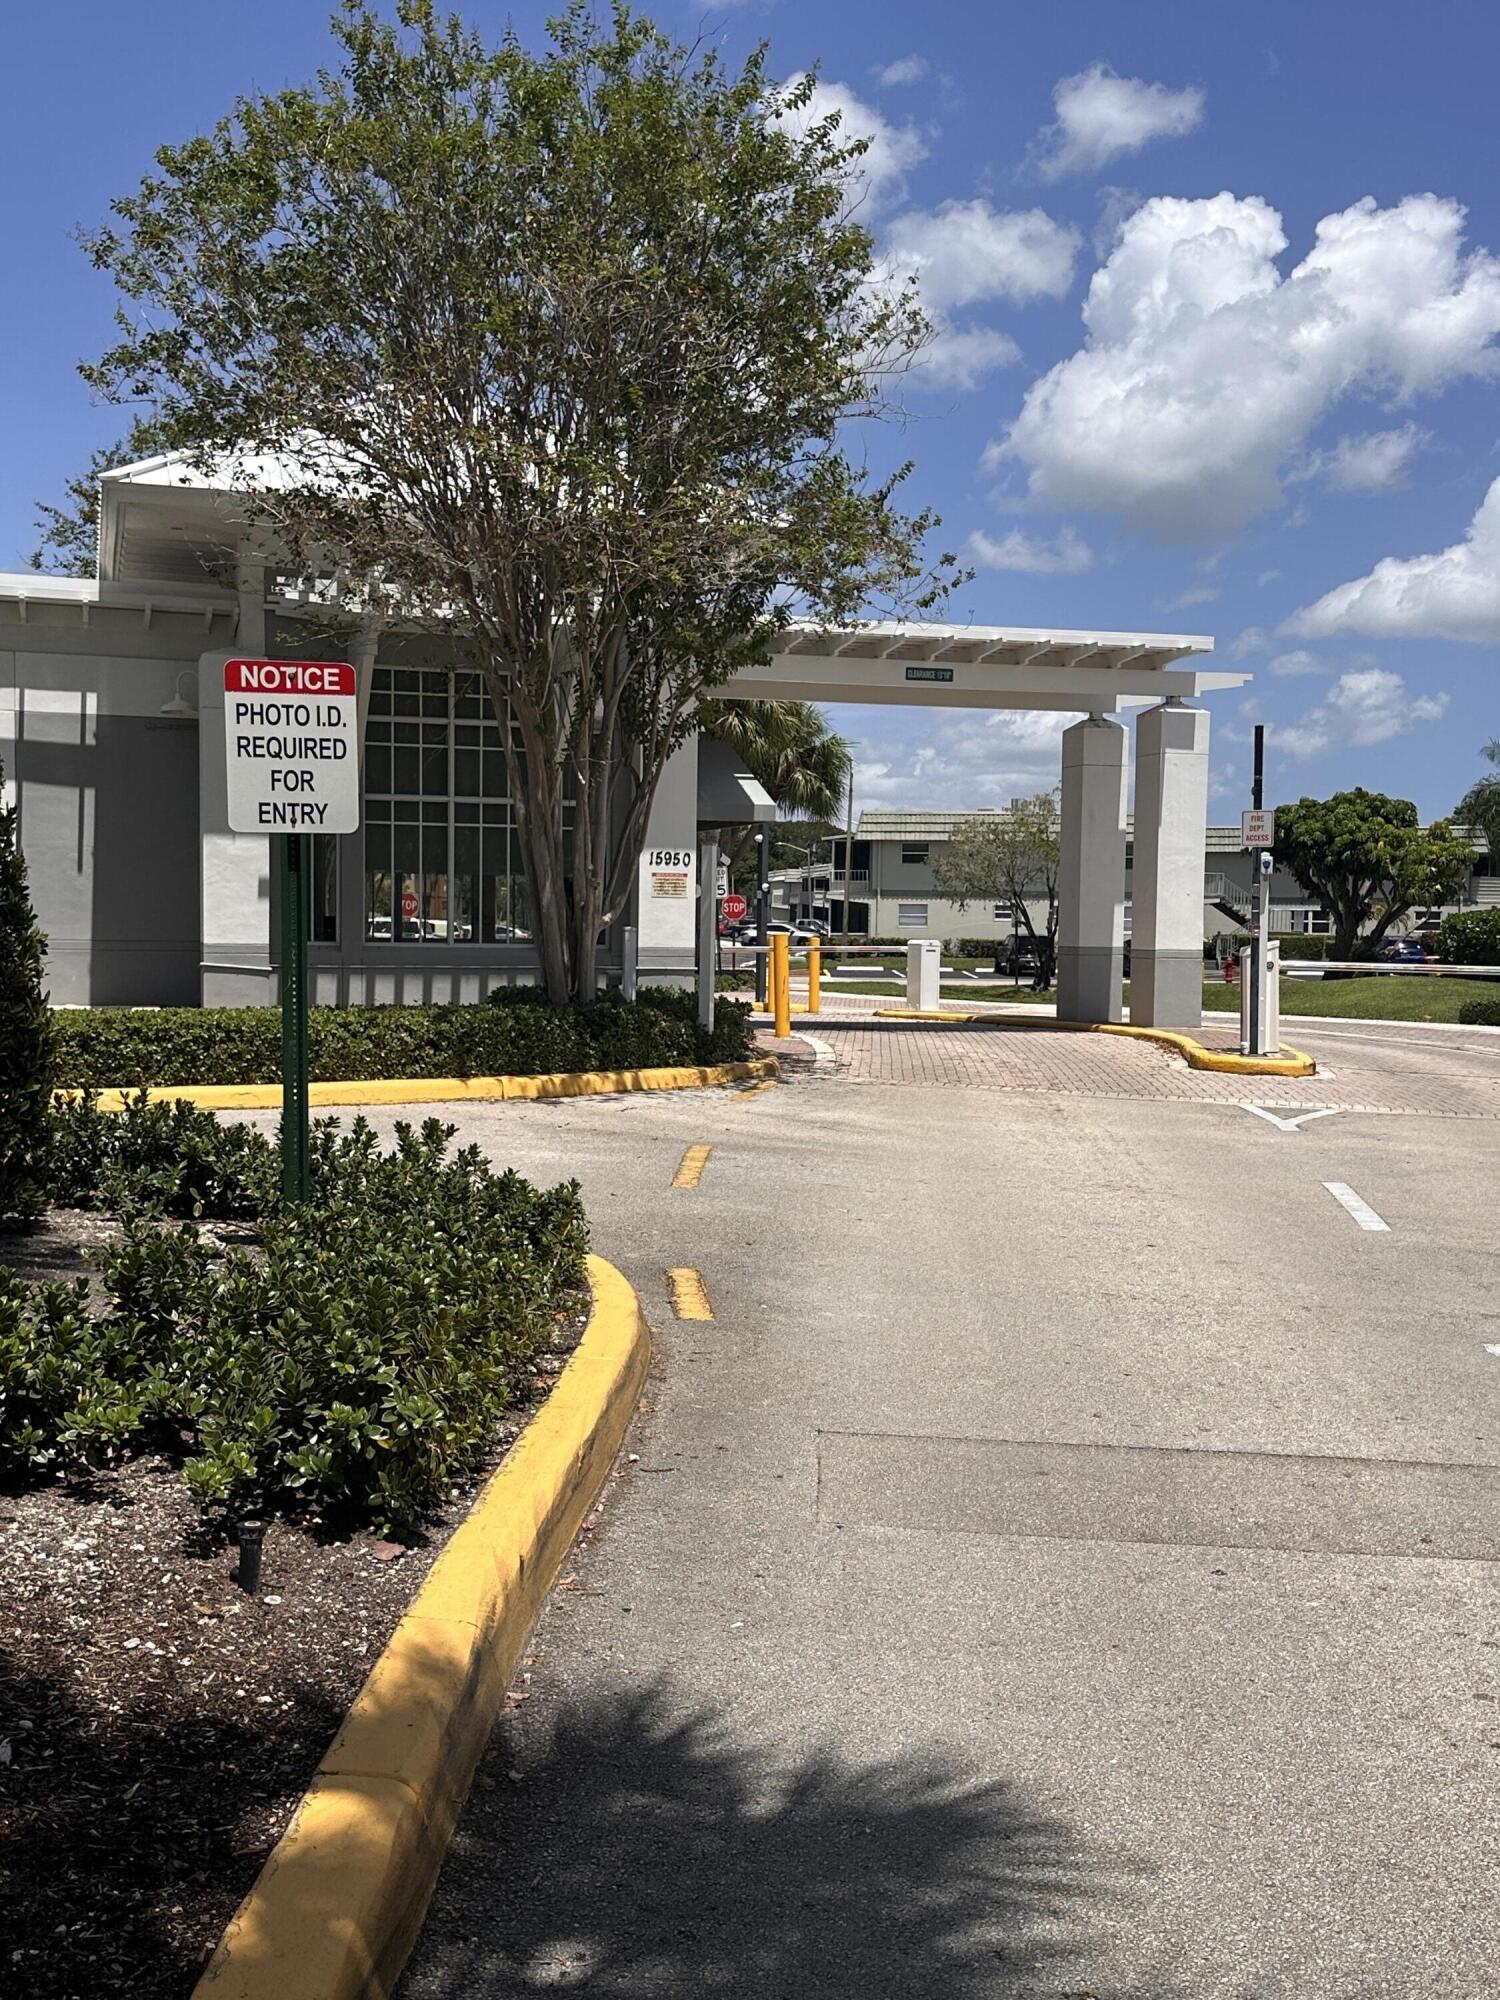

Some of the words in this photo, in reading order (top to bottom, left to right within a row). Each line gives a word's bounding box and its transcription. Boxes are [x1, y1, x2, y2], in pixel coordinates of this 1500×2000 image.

[240, 665, 341, 690] NOTICE
[235, 703, 310, 726] PHOTO
[316, 706, 347, 727] I.D.
[237, 736, 347, 760] REQUIRED
[271, 770, 315, 792] FOR
[258, 802, 328, 825] ENTRY
[1246, 834, 1269, 842] ACCESS
[649, 851, 691, 867] 15950
[723, 902, 745, 913] STOP
